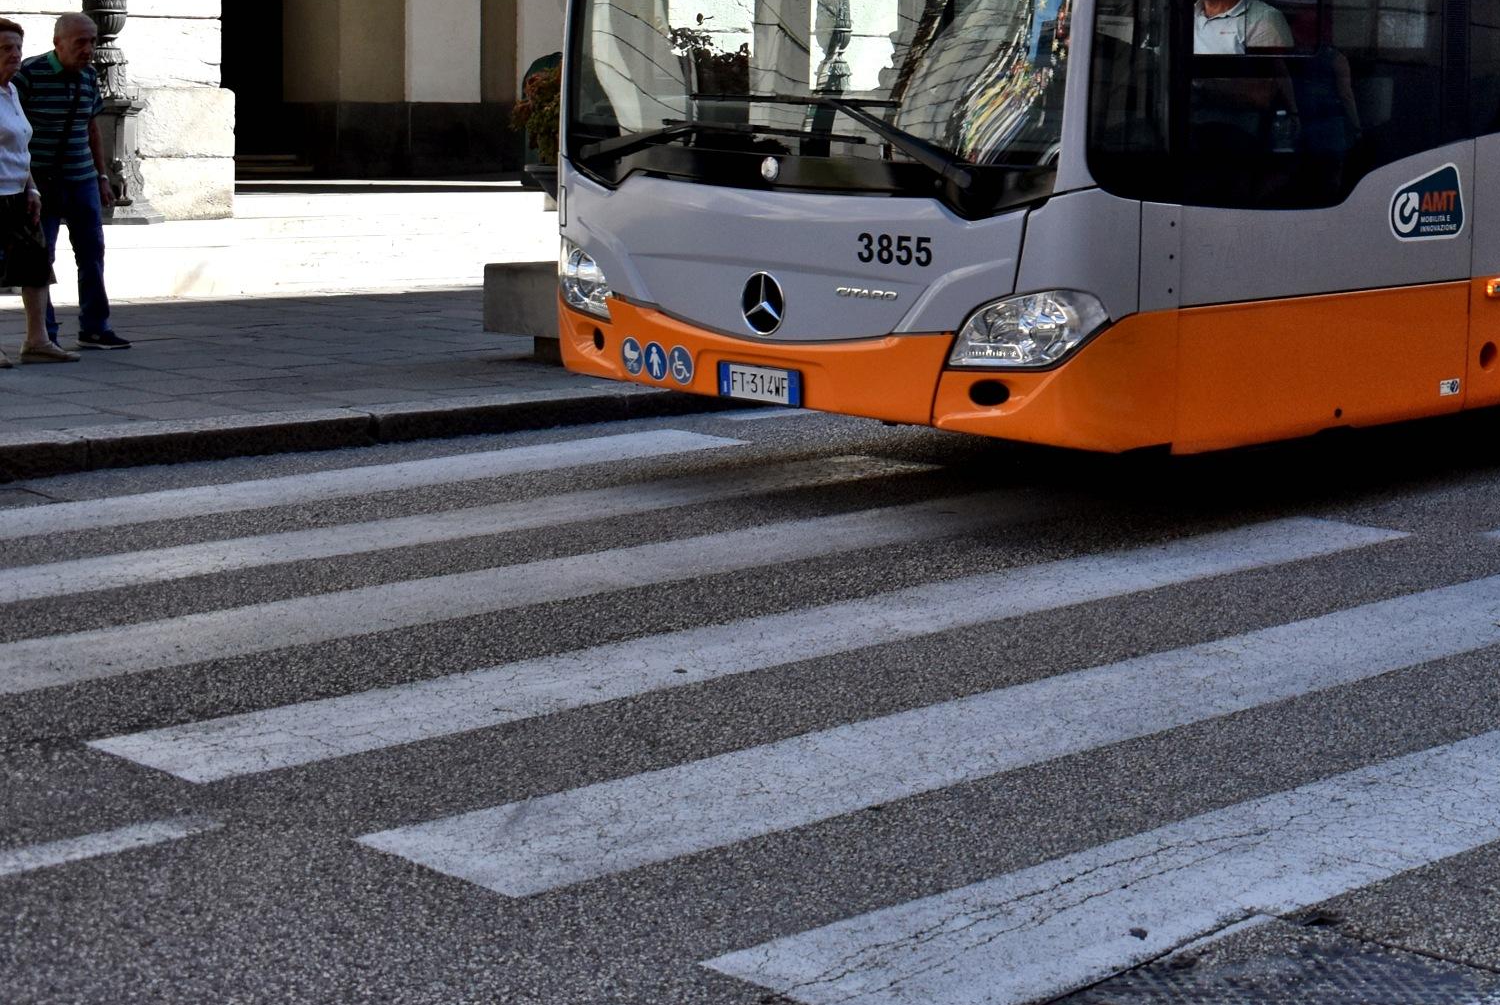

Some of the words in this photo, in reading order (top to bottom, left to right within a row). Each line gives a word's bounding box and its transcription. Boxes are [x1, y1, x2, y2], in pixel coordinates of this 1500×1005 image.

[1421, 190, 1457, 212] AMT
[1420, 223, 1457, 232] INNOVAZIONE
[857, 232, 933, 267] 3855
[835, 287, 899, 301] CITARO
